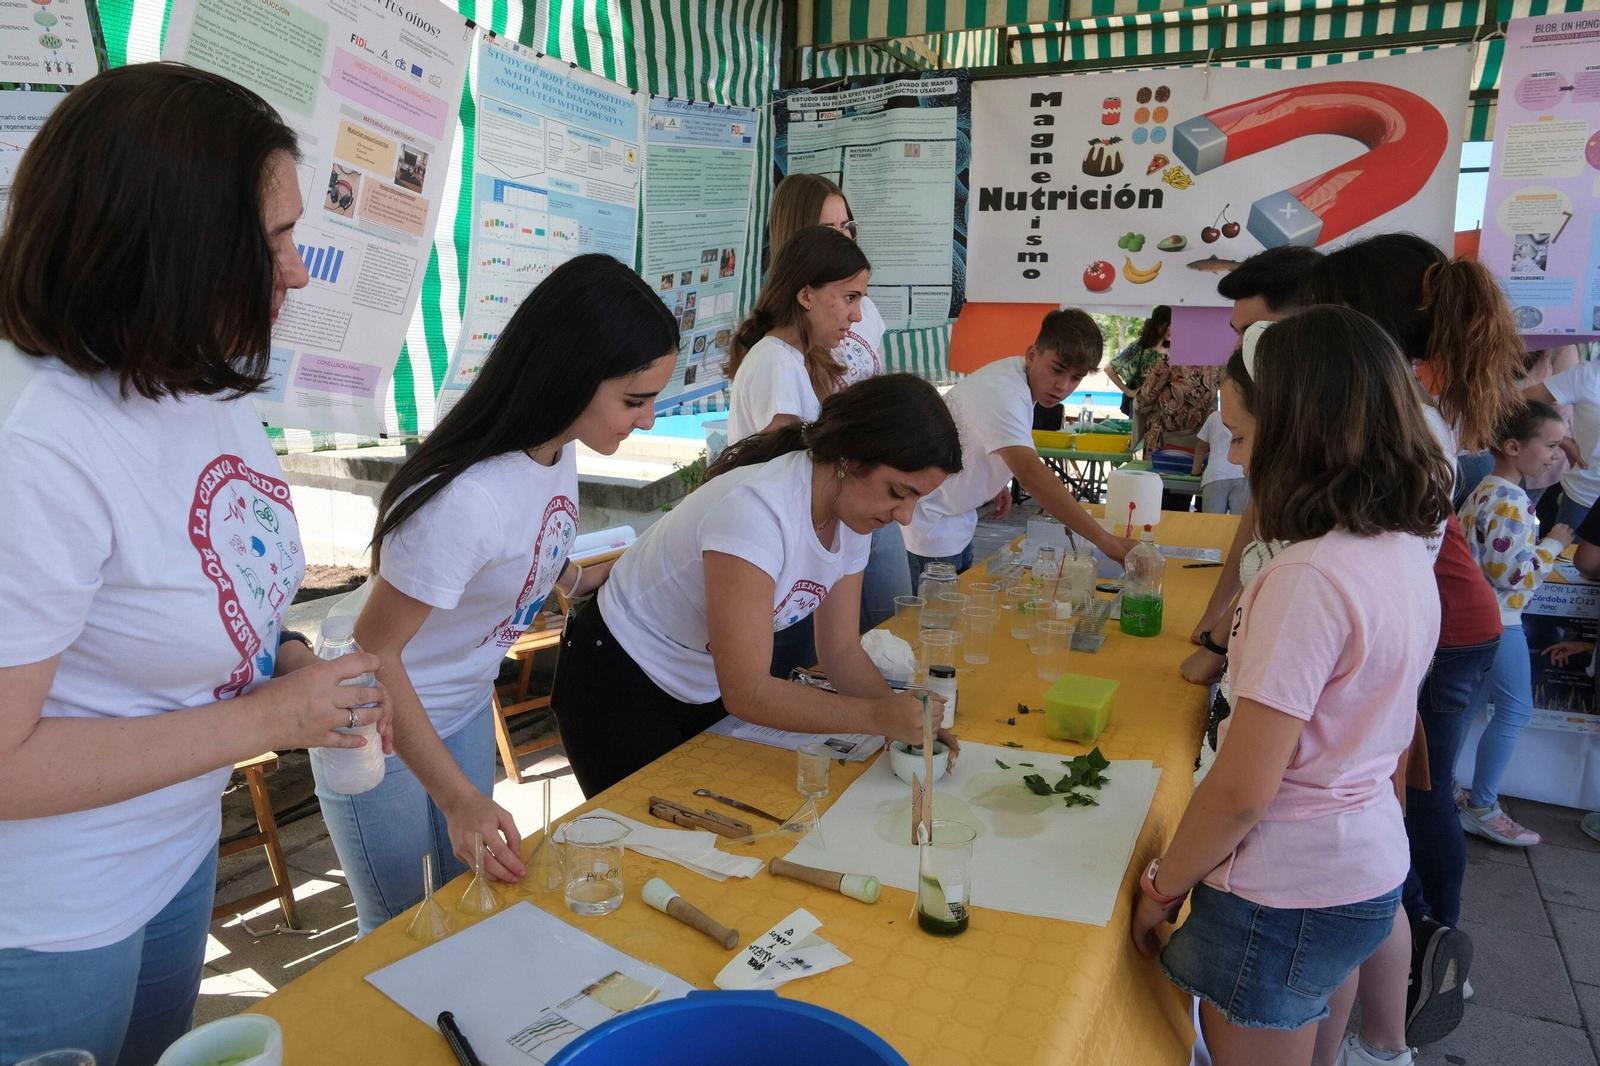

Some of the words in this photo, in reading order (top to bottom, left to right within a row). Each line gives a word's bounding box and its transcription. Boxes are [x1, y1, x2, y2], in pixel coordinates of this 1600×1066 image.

[405, 11, 441, 39] OÍDOS?
[1533, 33, 1574, 42] MOVIMIENTO
[1535, 24, 1559, 34] BLOB,
[1561, 22, 1574, 31] UN
[353, 61, 382, 78] OBJETIVOS
[381, 74, 389, 82] DE
[388, 77, 397, 85] LA
[395, 81, 432, 103] INVESTIGACIÓN
[487, 50, 523, 68] STUDY
[524, 64, 537, 75] OF
[540, 70, 564, 87] BODY
[566, 81, 634, 108] COMPOSITION
[504, 67, 531, 84] WITH
[533, 78, 540, 87] A
[542, 82, 564, 97] RISK
[566, 91, 617, 114] DIAGNOSIS
[792, 95, 819, 103] ESTUDIO
[848, 87, 884, 98] EFECTIVIDAD
[895, 81, 920, 90] LAVADO
[494, 77, 555, 104] ASSOCIATED
[559, 99, 583, 114] WITH
[585, 108, 625, 127] OBESITY
[800, 101, 821, 109] SEGÚN
[873, 92, 883, 100] LOS
[884, 88, 918, 98] PRODUCTOS
[346, 126, 364, 137] Material
[362, 134, 389, 148] experimental
[362, 116, 390, 131] MATERIALES
[393, 128, 416, 142] MÉTODOS
[978, 183, 1164, 212] Nutrición
[1017, 92, 1063, 279] Magnetismo
[316, 357, 347, 370] CONCLUSIÓN
[193, 507, 208, 538] LA
[202, 547, 232, 592] POR
[1532, 594, 1566, 604] Córdoba
[1570, 595, 1595, 605] 2023
[1544, 585, 1564, 594] POR
[1566, 586, 1578, 594] LA
